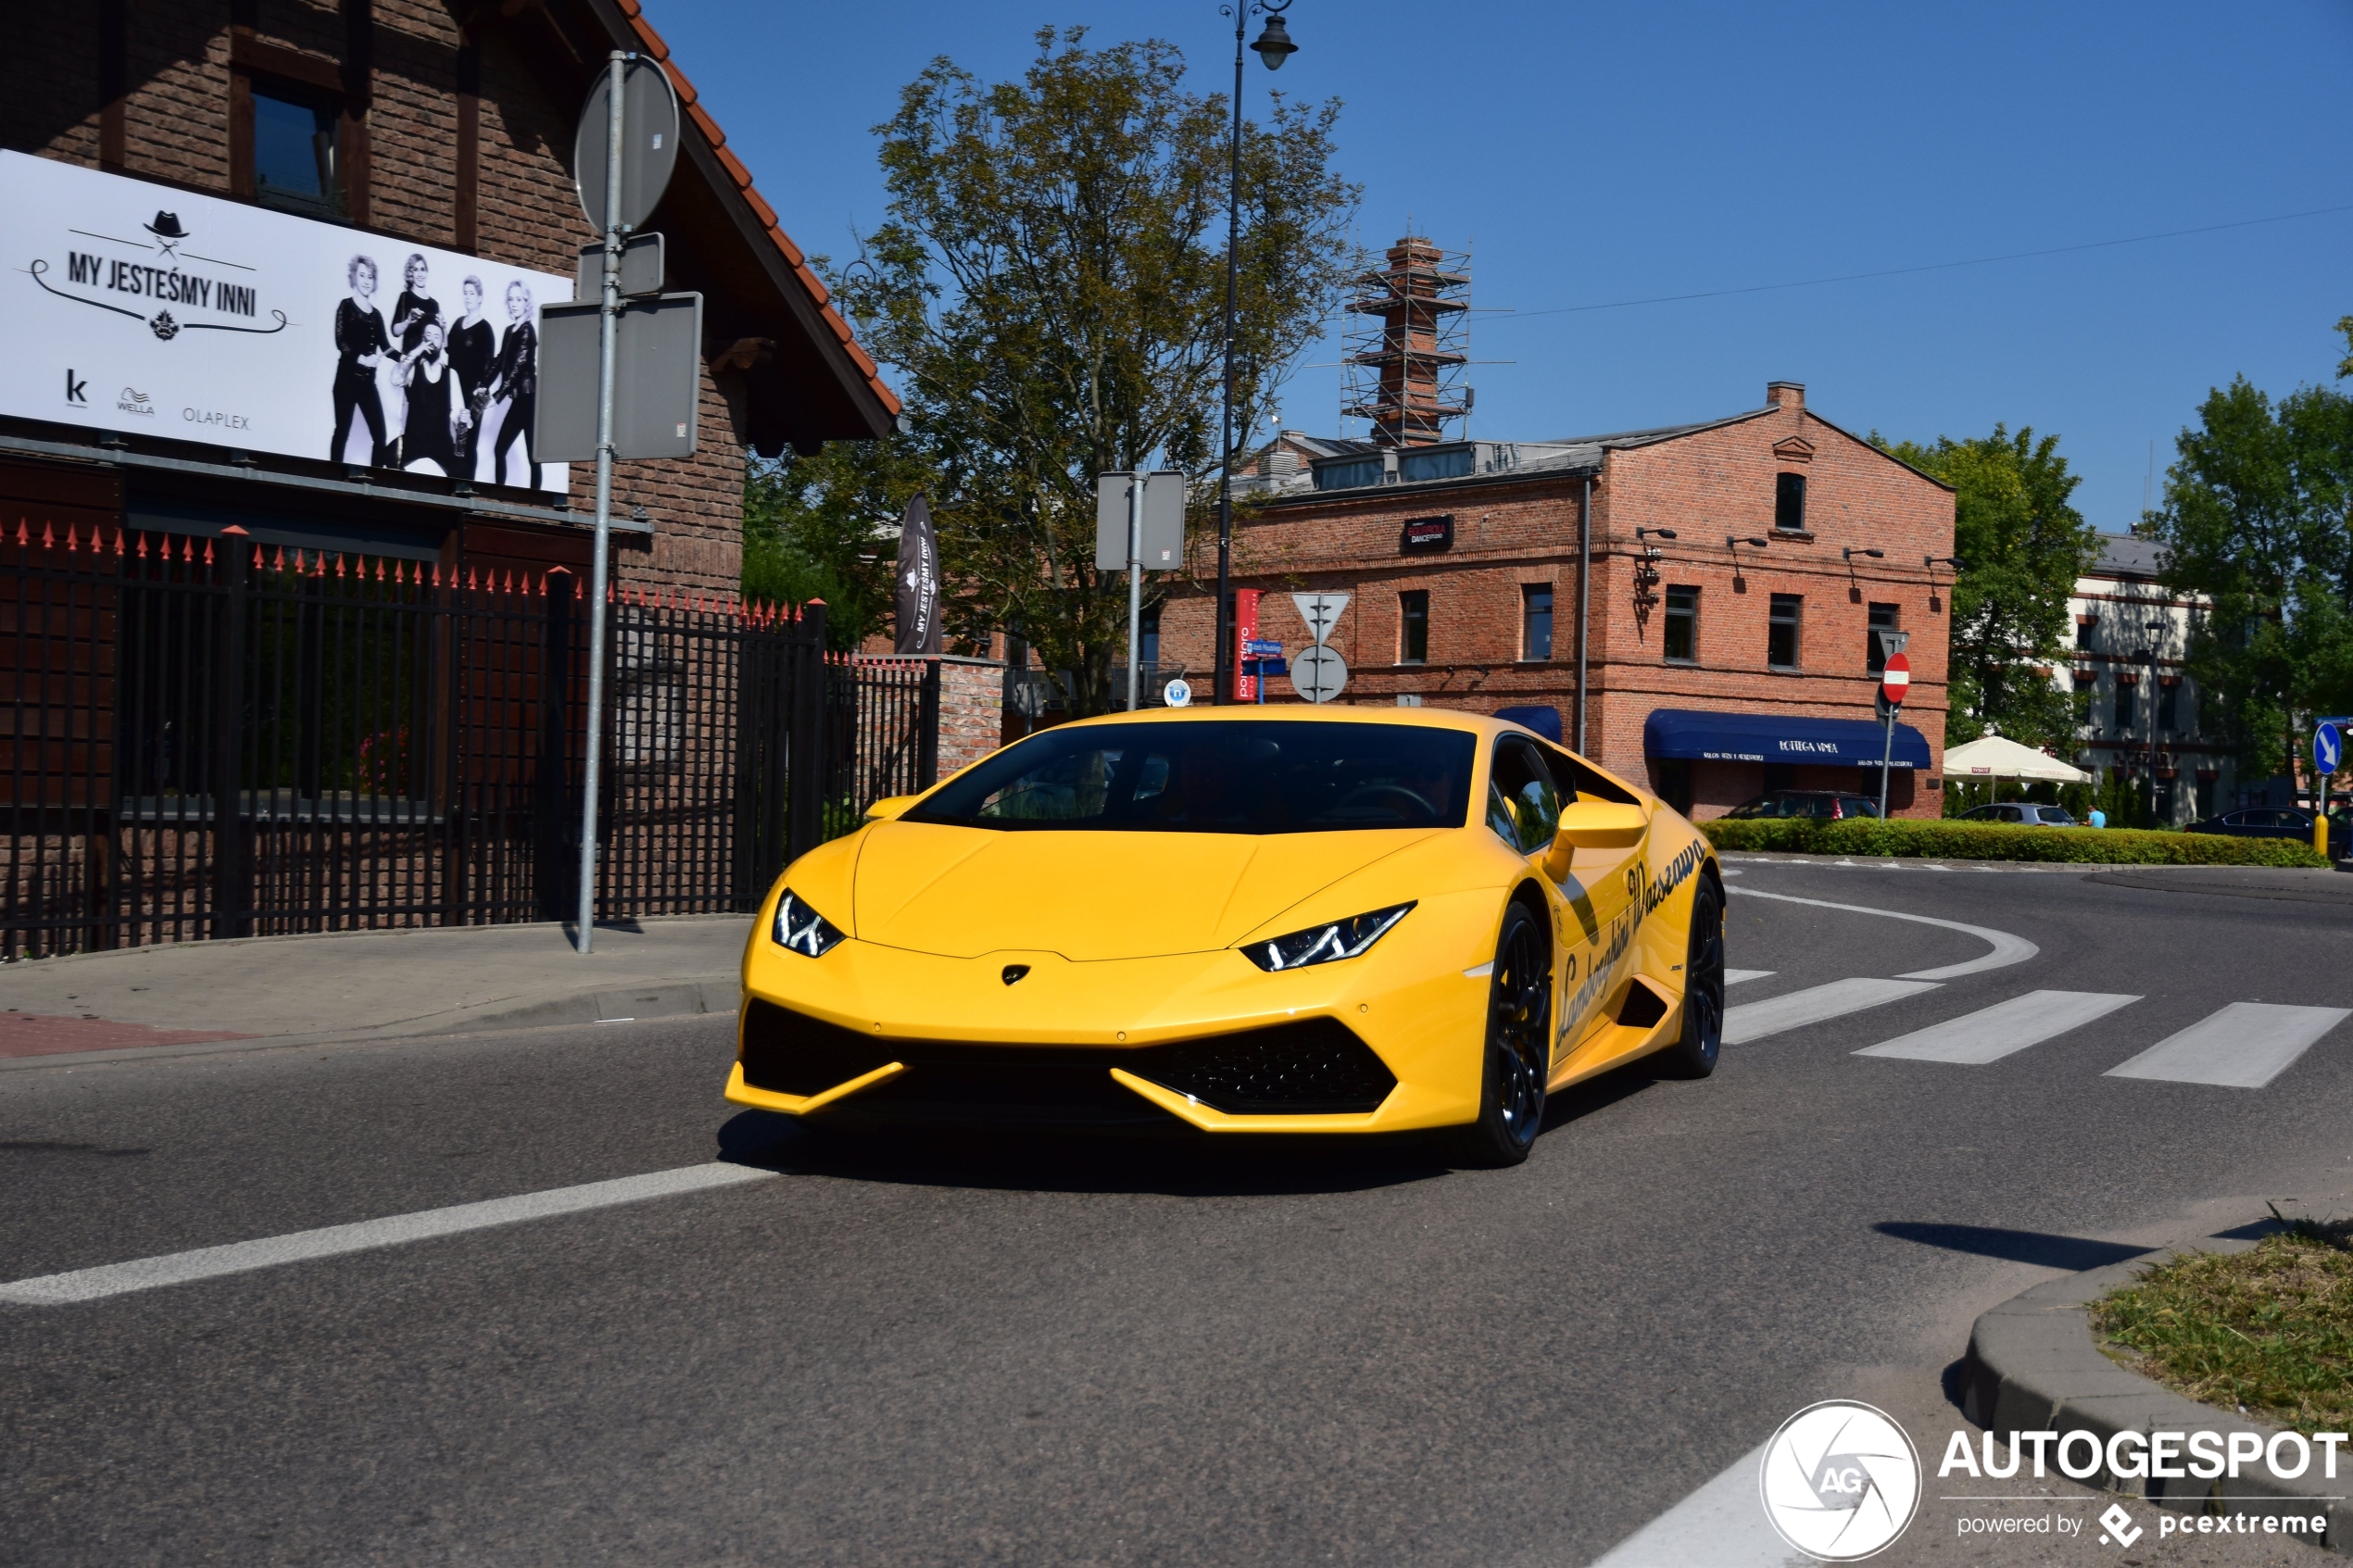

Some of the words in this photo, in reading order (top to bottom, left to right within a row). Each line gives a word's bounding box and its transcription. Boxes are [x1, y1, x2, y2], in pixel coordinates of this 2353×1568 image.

[69, 251, 102, 286] MY
[107, 258, 211, 307] JESTEŚMY
[216, 282, 257, 317] INNI
[117, 401, 156, 416] WELLA
[182, 408, 250, 431] OLAPLEX
[1407, 524, 1446, 536] EGURROLA
[916, 615, 926, 633] MY
[1239, 627, 1249, 697] podoro
[1780, 740, 1815, 752] BOTTEGA
[1556, 905, 1629, 1048] Lamborghini
[1628, 838, 1705, 935] Warszawa
